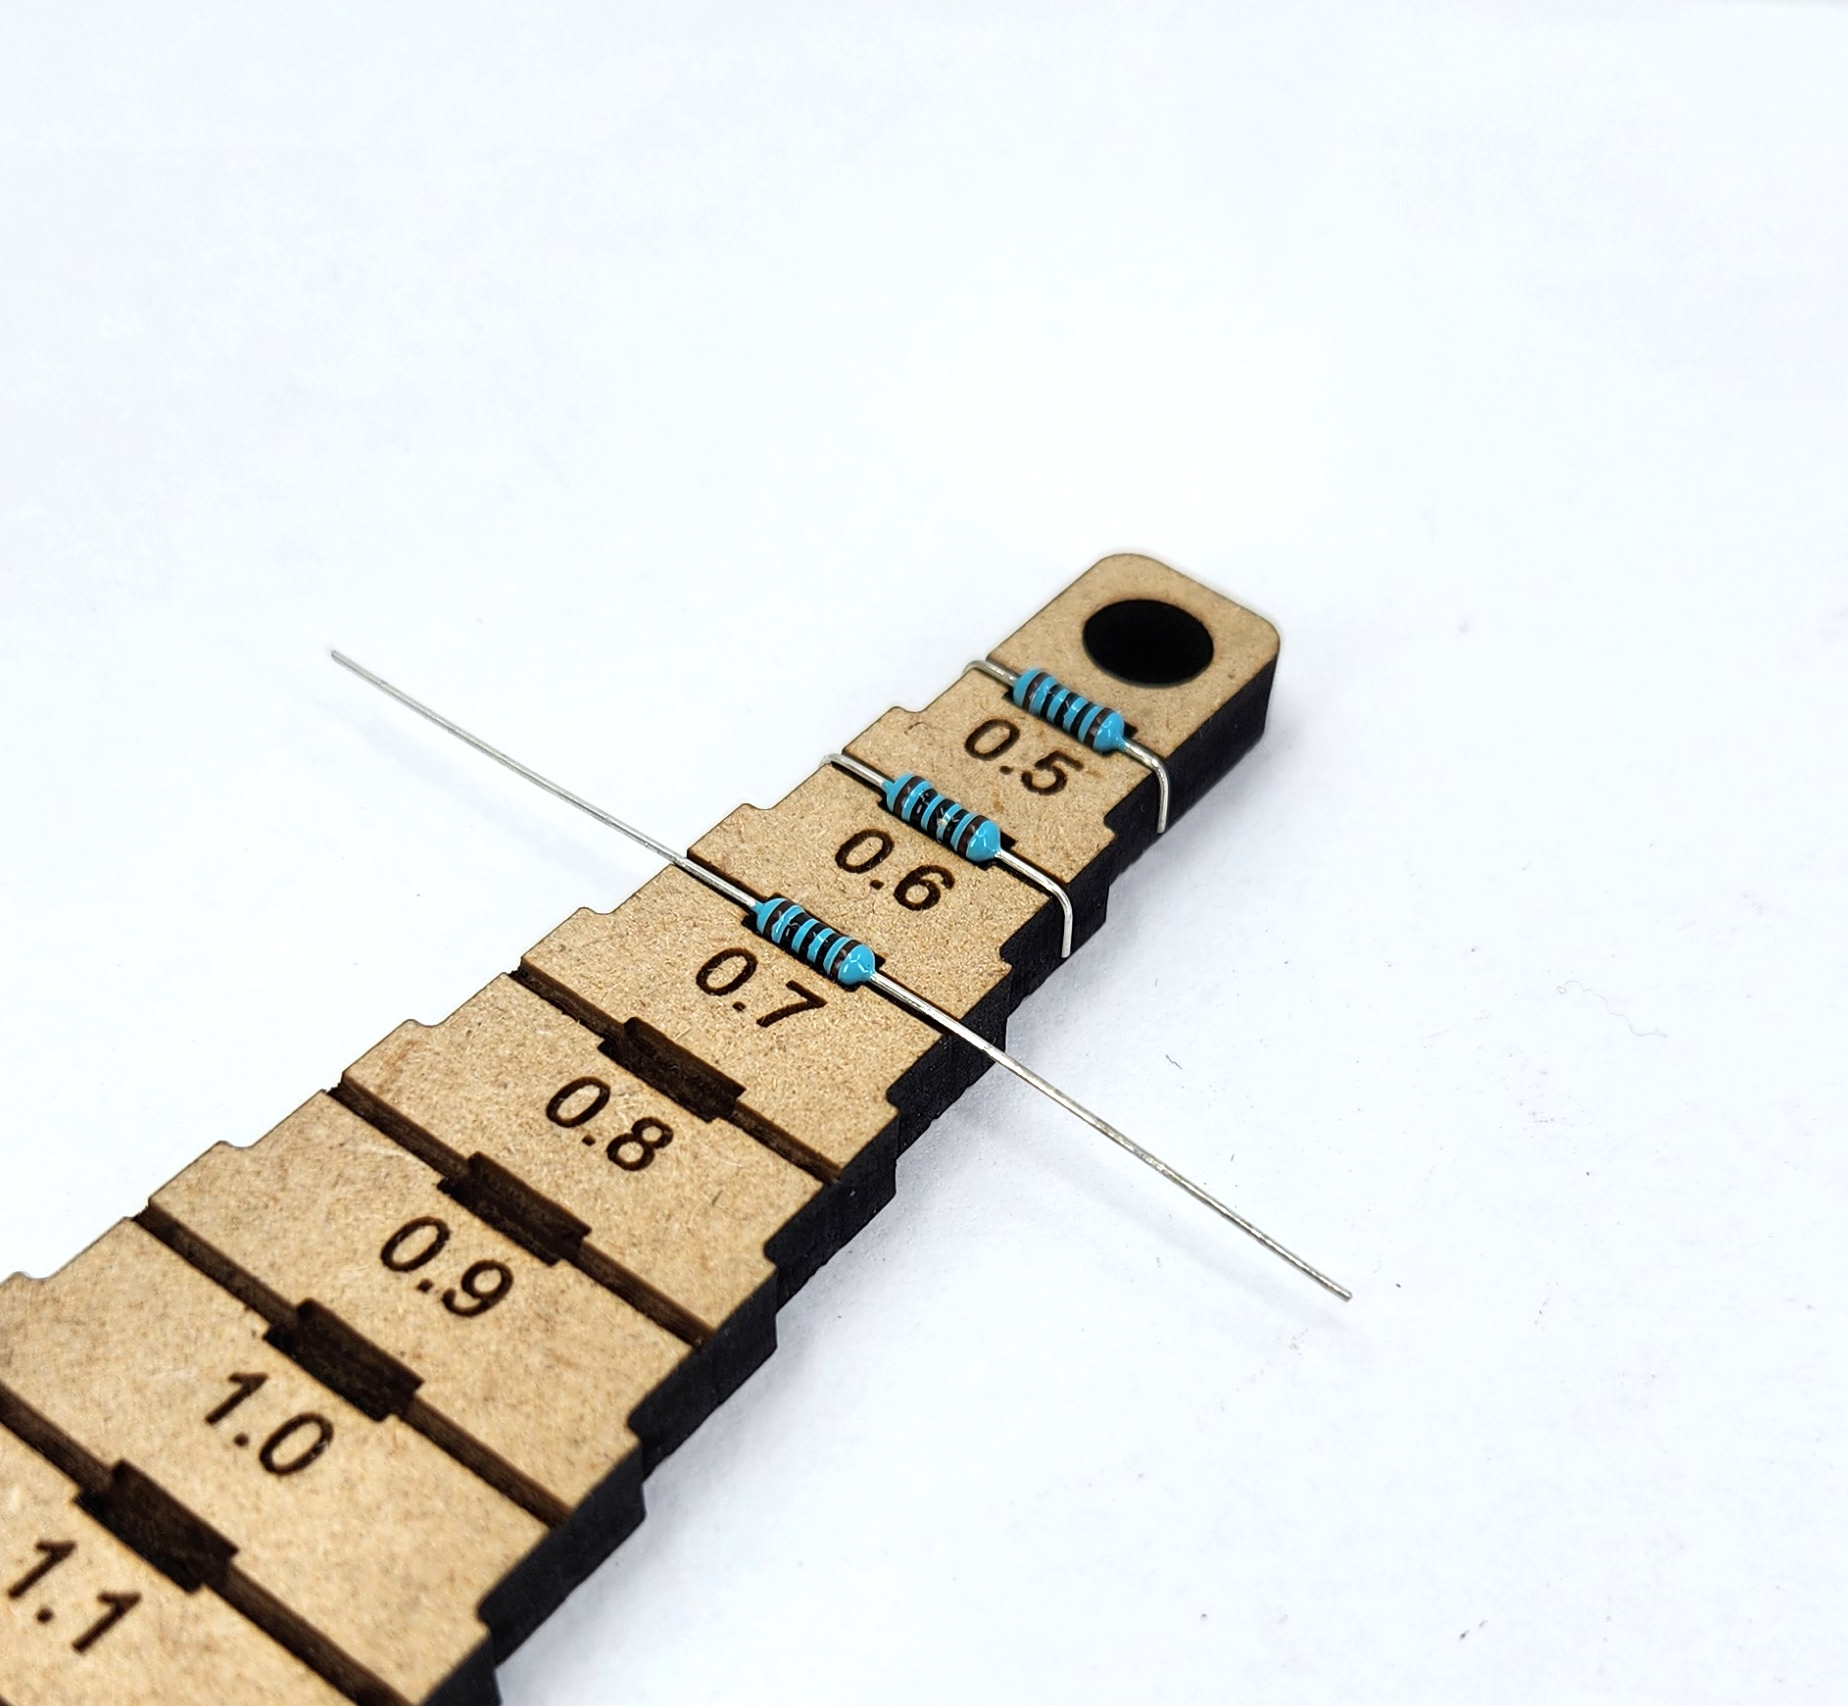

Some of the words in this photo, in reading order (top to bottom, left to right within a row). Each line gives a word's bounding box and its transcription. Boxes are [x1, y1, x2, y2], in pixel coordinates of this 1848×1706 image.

[964, 717, 1084, 796] 0.5
[834, 828, 955, 912] 0.6
[695, 947, 827, 1028] 0.7
[545, 1076, 674, 1172] 0.8
[379, 1216, 514, 1318] 0.9
[204, 1370, 334, 1477] 1.0
[8, 1538, 142, 1653] 1.1
